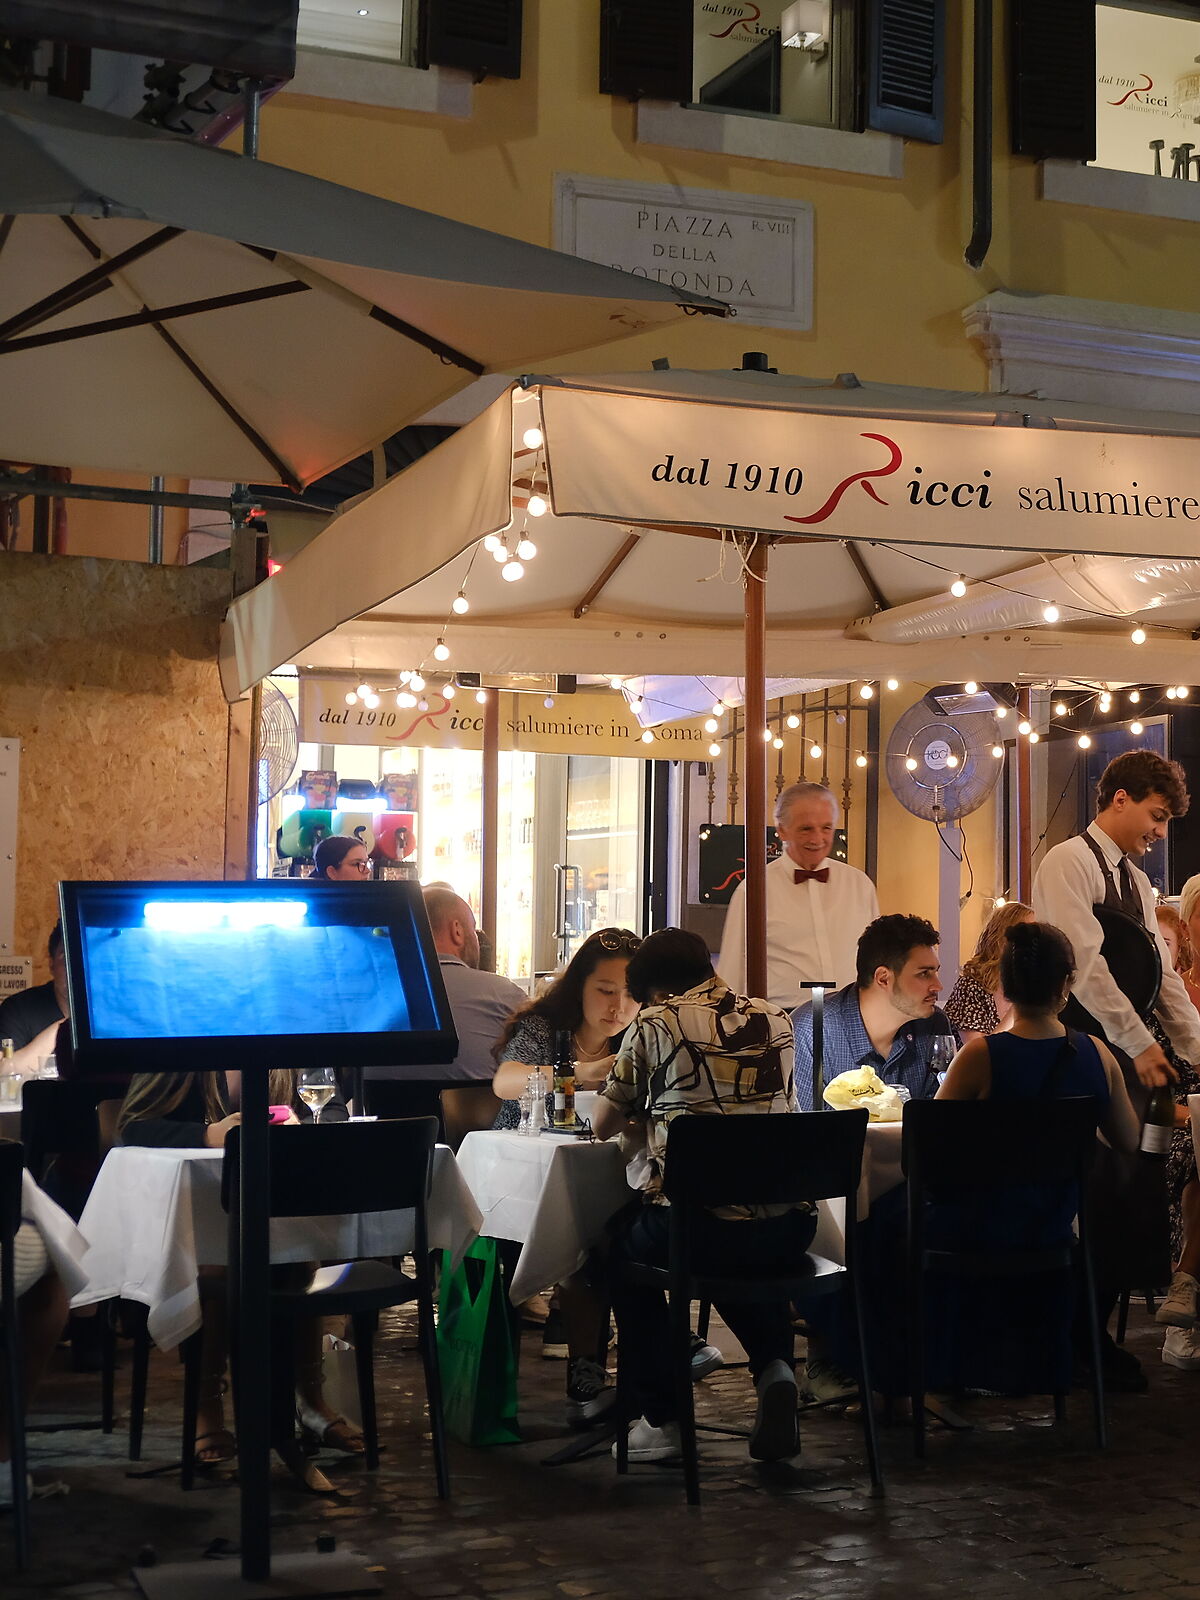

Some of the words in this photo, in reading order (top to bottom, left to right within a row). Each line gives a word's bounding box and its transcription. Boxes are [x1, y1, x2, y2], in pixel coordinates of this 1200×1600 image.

[702, 3, 718, 13] dal
[721, 5, 743, 17] 1910
[1098, 75, 1113, 86] dal
[1106, 73, 1168, 106] Ricci
[1116, 77, 1135, 88] 1910
[637, 209, 732, 239] PIAZZA
[767, 222, 789, 235] VIII
[652, 243, 717, 263] DELLA
[651, 454, 710, 486] dal
[724, 462, 803, 496] 1910
[783, 432, 993, 525] Ricci
[1017, 477, 1200, 521] salumiere
[318, 708, 349, 725] dal
[356, 711, 397, 728] 1910
[385, 692, 484, 741] Ricc
[506, 714, 604, 737] salumiere
[611, 718, 630, 738] in
